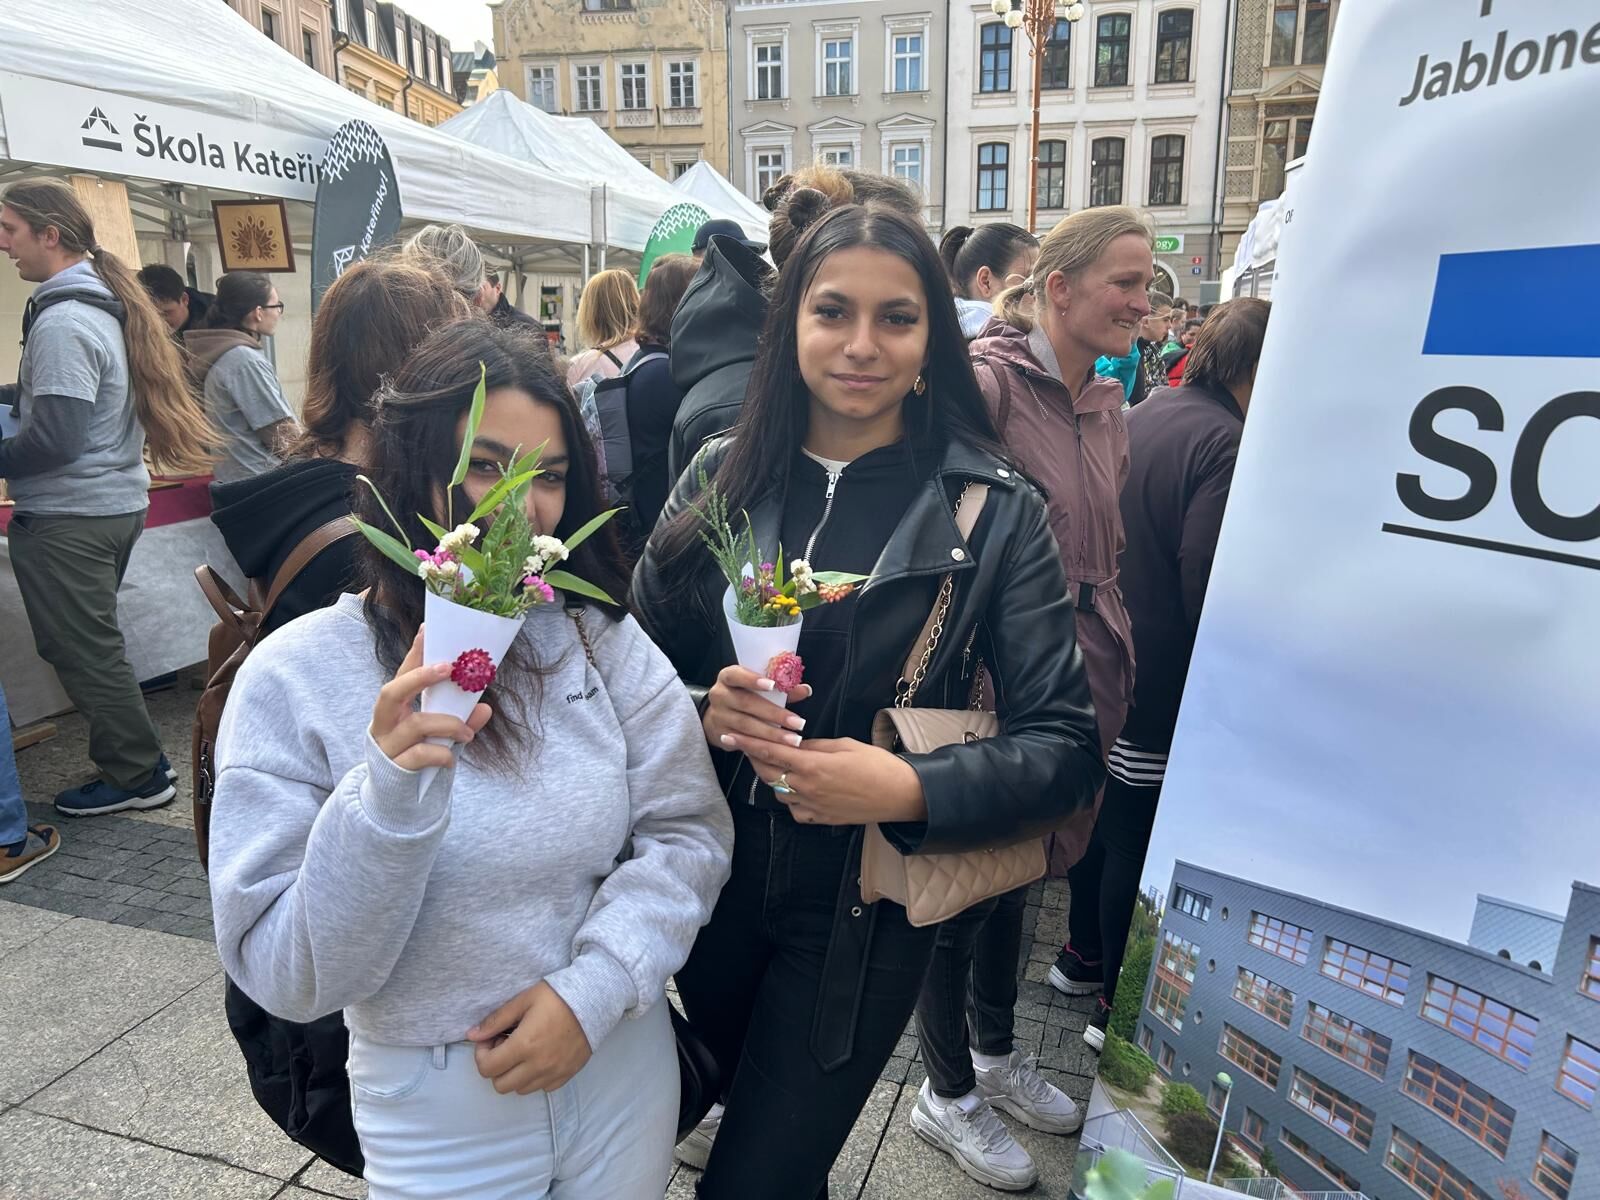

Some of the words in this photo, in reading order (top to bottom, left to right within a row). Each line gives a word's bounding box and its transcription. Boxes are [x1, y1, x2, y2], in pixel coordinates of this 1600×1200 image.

[133, 114, 226, 169] Škola
[360, 169, 389, 255] Kateřinky!
[566, 691, 583, 703] find
